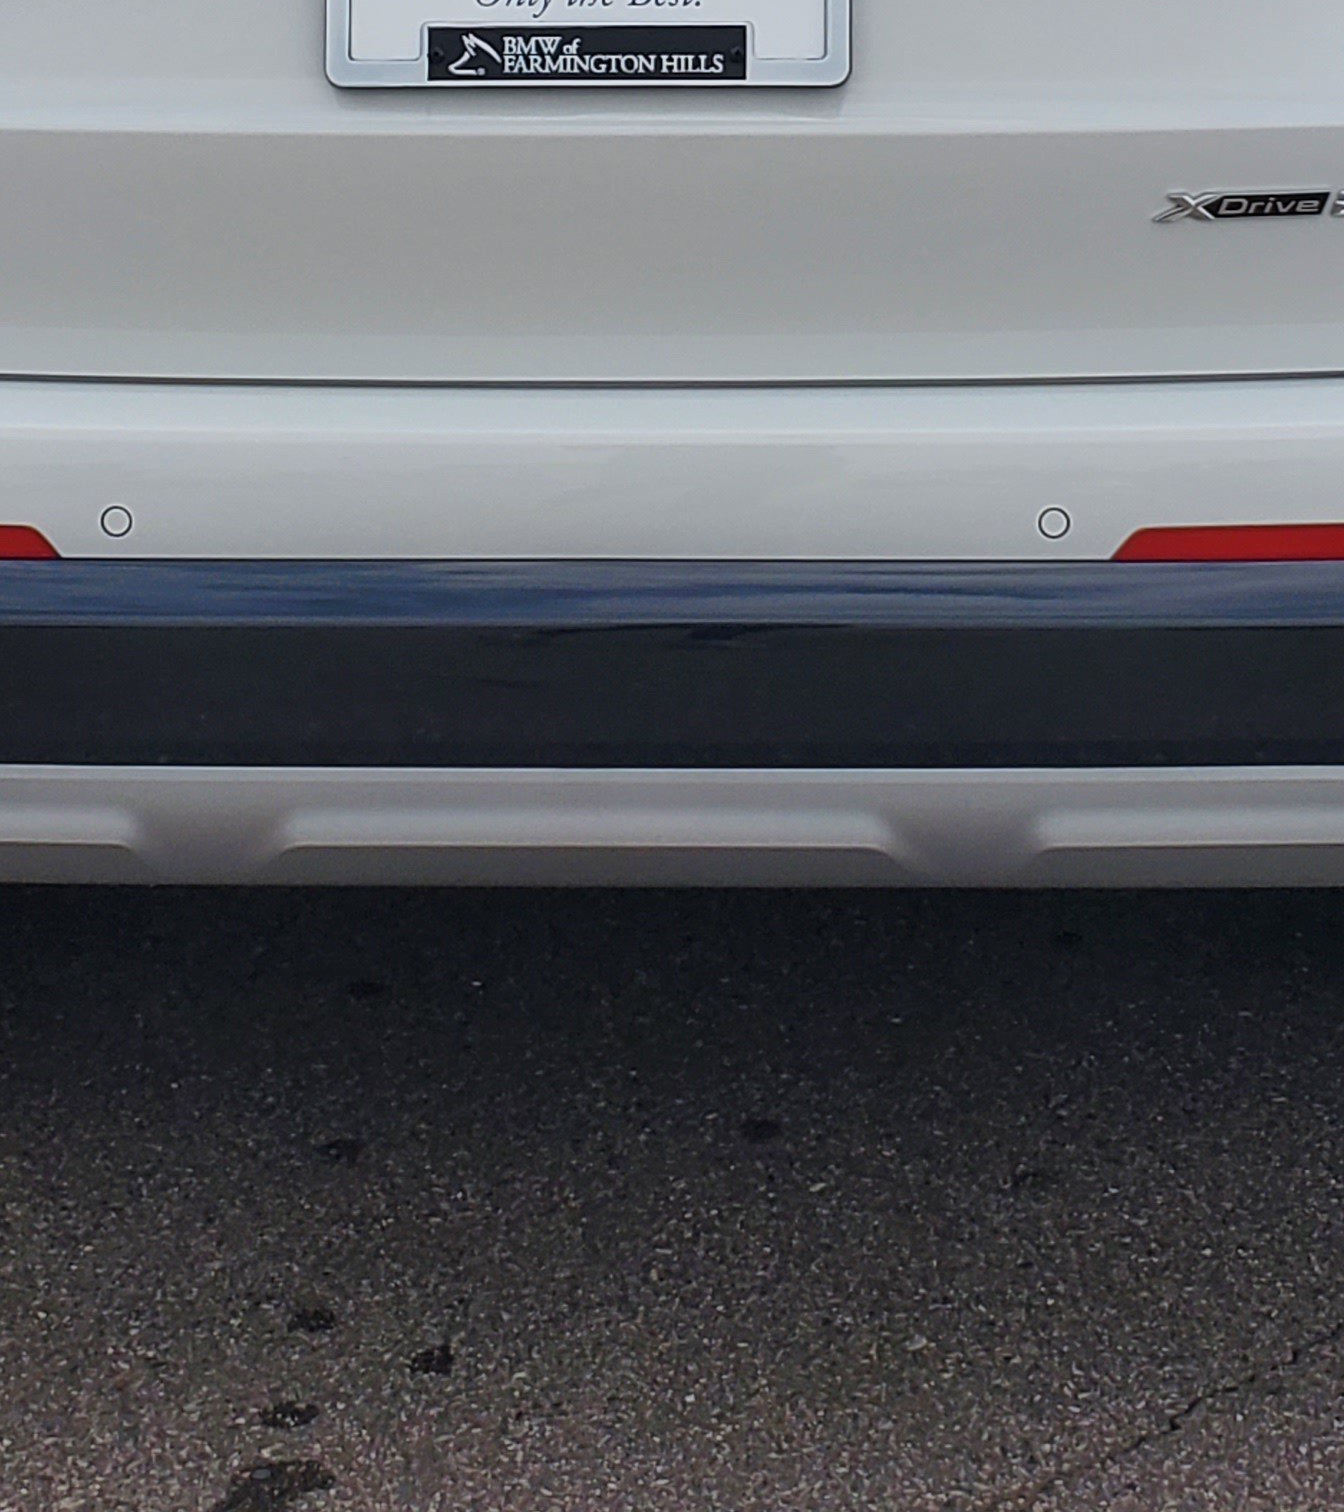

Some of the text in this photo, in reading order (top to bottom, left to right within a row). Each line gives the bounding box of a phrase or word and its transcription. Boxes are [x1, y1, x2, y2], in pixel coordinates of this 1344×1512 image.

[503, 36, 581, 55] BMW of
[503, 54, 724, 74] FARMINGTON HILLS
